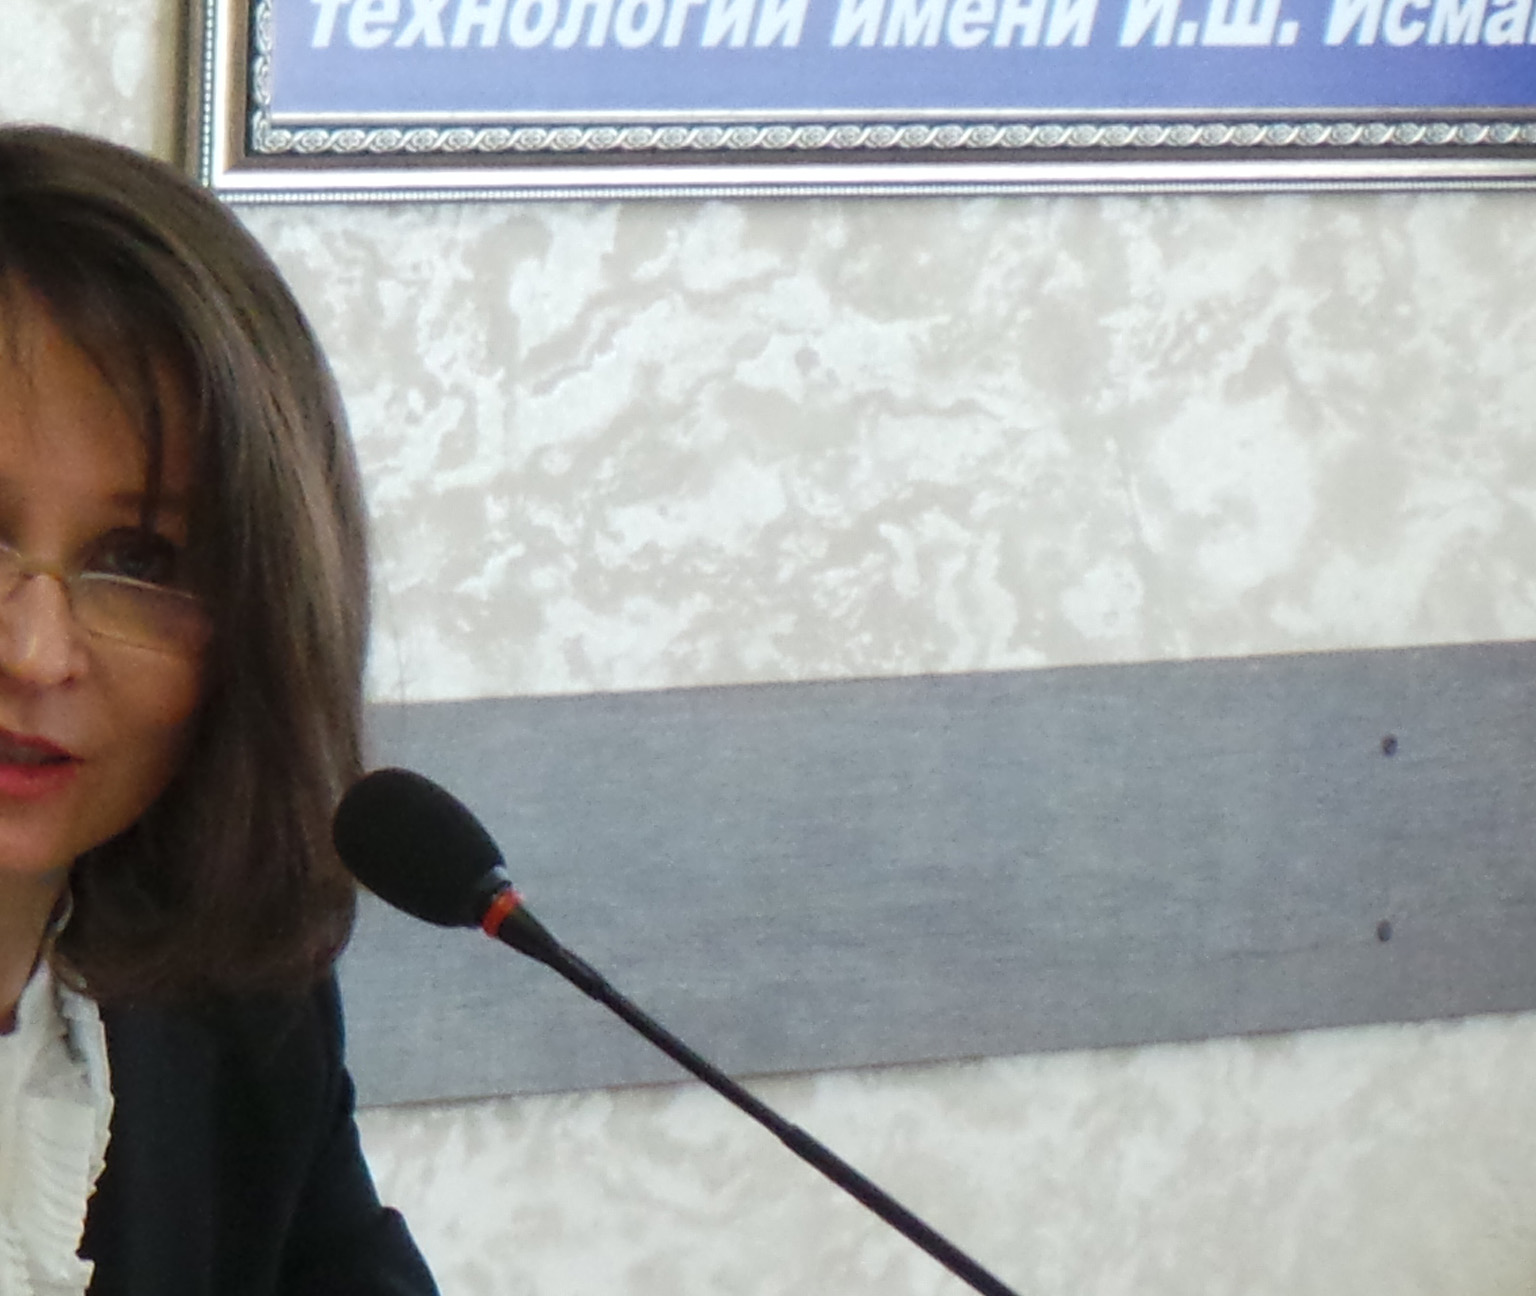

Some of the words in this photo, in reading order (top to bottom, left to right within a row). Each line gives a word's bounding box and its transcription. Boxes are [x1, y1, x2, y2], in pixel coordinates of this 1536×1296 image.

[830, 0, 1099, 48] имени
[1118, 0, 1300, 48] И.Ш.
[1324, 0, 1536, 49] Исма
